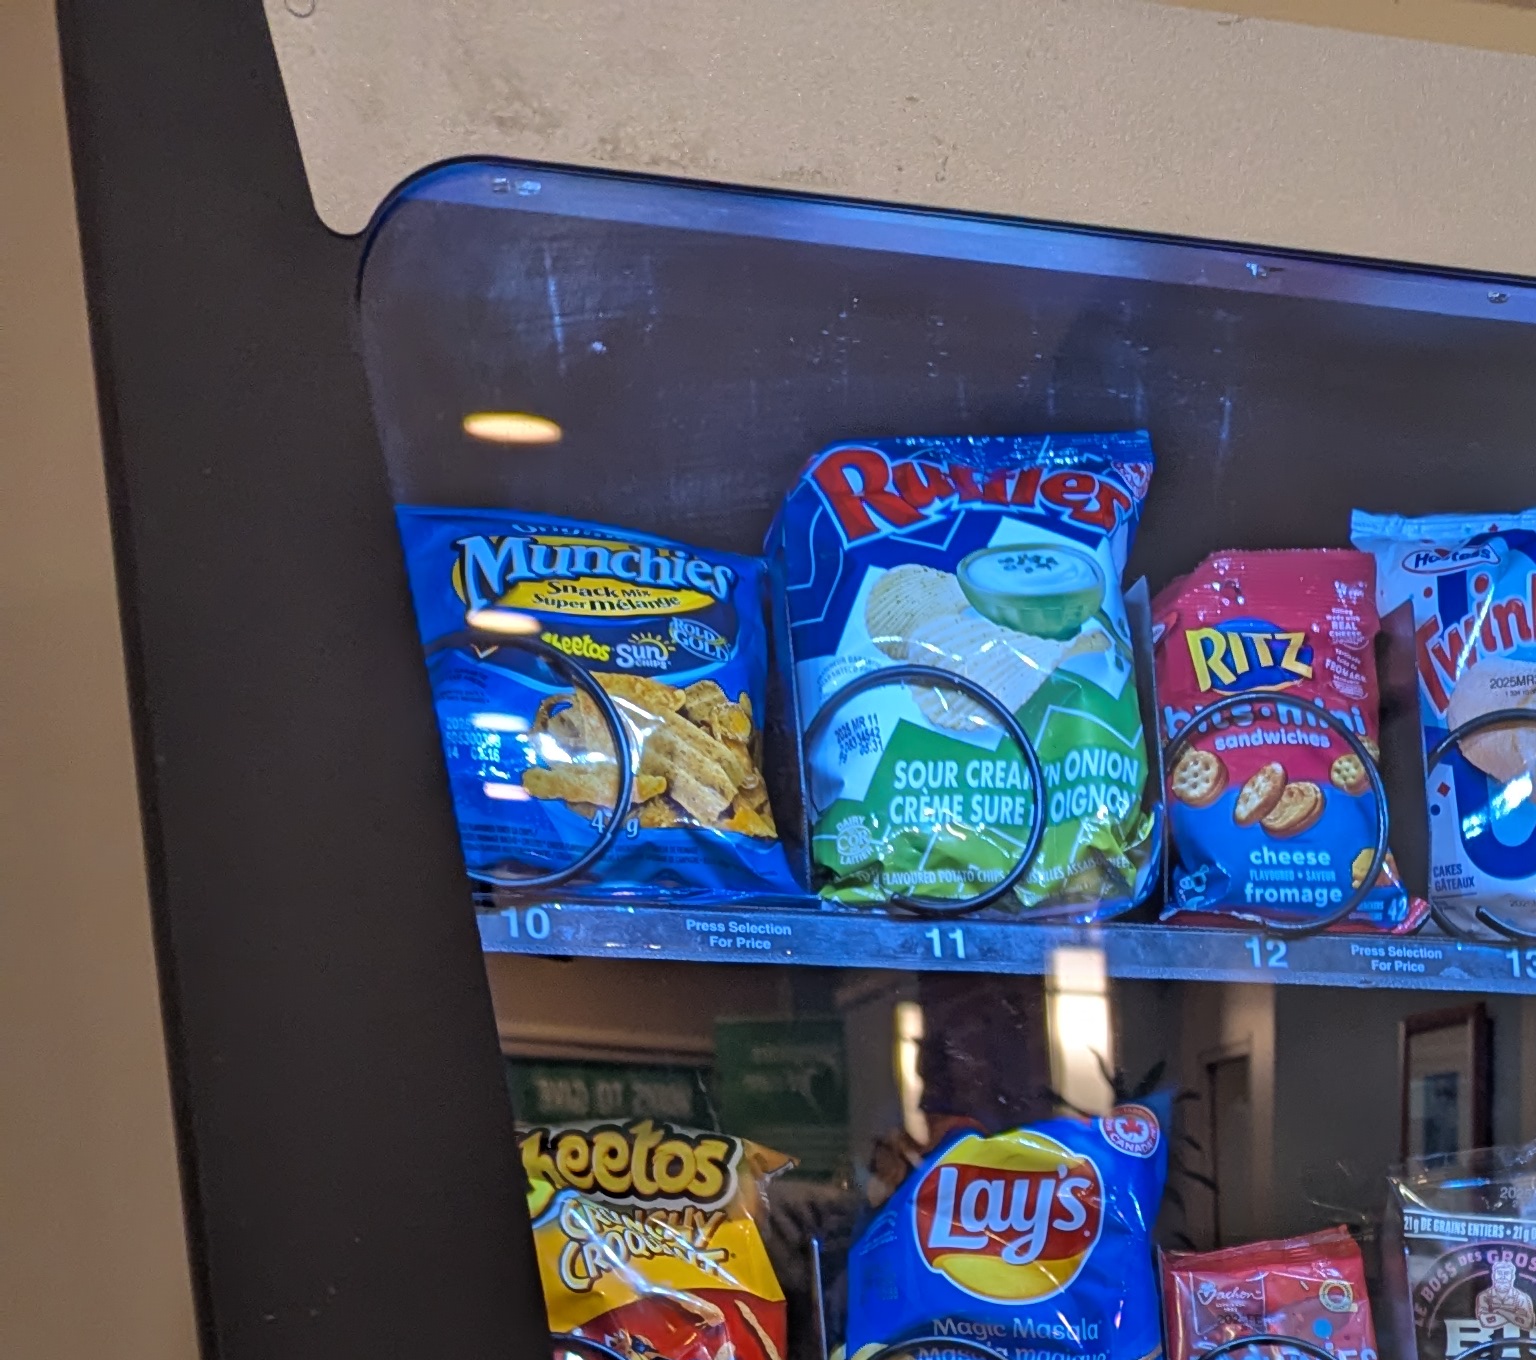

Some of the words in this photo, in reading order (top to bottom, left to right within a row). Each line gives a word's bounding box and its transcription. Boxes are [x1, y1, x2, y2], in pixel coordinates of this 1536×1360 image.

[455, 535, 735, 613] Munchies
[548, 580, 619, 598] Snack
[621, 588, 651, 598] Mix
[532, 592, 587, 610] Super
[616, 636, 669, 668] Sun
[1185, 628, 1313, 692] RITZ
[1214, 728, 1331, 751] sandwiches
[894, 760, 958, 790] SOUR
[1064, 749, 1139, 785] ONION
[889, 786, 963, 825] CRÈME
[970, 799, 1025, 826] SURE
[1051, 784, 1140, 823] OIGNON
[1250, 846, 1331, 866] cheese
[938, 868, 975, 884] POTATO
[1250, 869, 1295, 882] FLAVOURED
[1306, 869, 1336, 882] SAVEUR
[1433, 863, 1463, 878] CAKES
[1244, 883, 1342, 908] fromage
[1435, 876, 1476, 892] GÂTEAUX
[500, 906, 550, 940] 10
[686, 918, 726, 933] Press
[728, 919, 792, 937] Selection
[709, 935, 733, 949] For
[734, 936, 772, 951] Price
[925, 928, 966, 959] 11
[1245, 937, 1289, 969] 12
[1351, 943, 1385, 957] Press
[1387, 944, 1443, 960] Selection
[1371, 959, 1392, 972] For
[1394, 960, 1426, 973] Price
[519, 1120, 728, 1198] heetos
[928, 1164, 1095, 1264] Lay's
[1433, 1219, 1467, 1236] GRAINS
[1468, 1222, 1504, 1238] ENTIERS
[933, 1317, 1007, 1340] Magic
[1013, 1317, 1099, 1340] Masala
